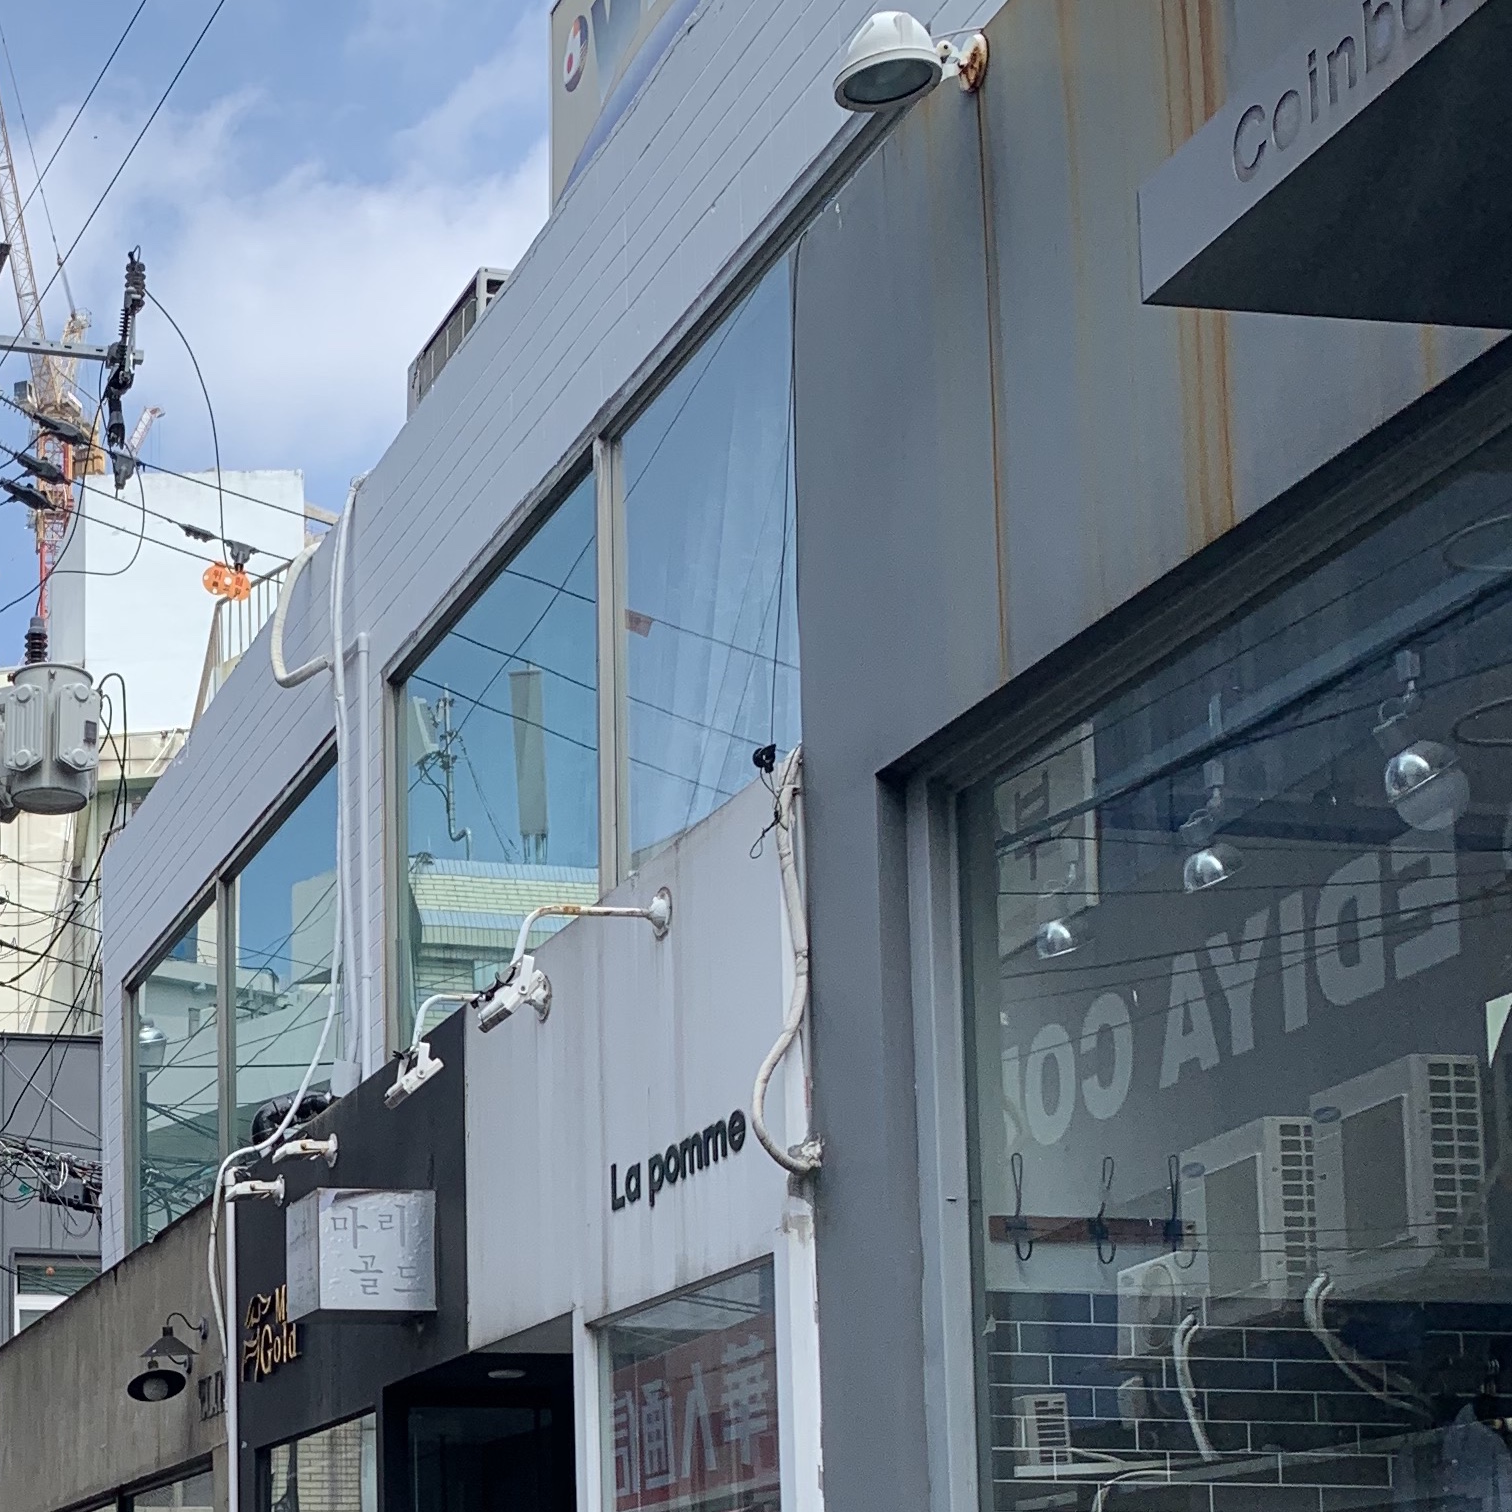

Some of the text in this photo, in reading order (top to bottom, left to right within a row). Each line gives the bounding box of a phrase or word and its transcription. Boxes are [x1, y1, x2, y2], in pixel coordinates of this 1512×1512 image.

[610, 1108, 747, 1211] La pomme
[330, 1203, 406, 1250] 마리
[349, 1254, 426, 1296] 골드
[261, 1321, 300, 1375] Gold
